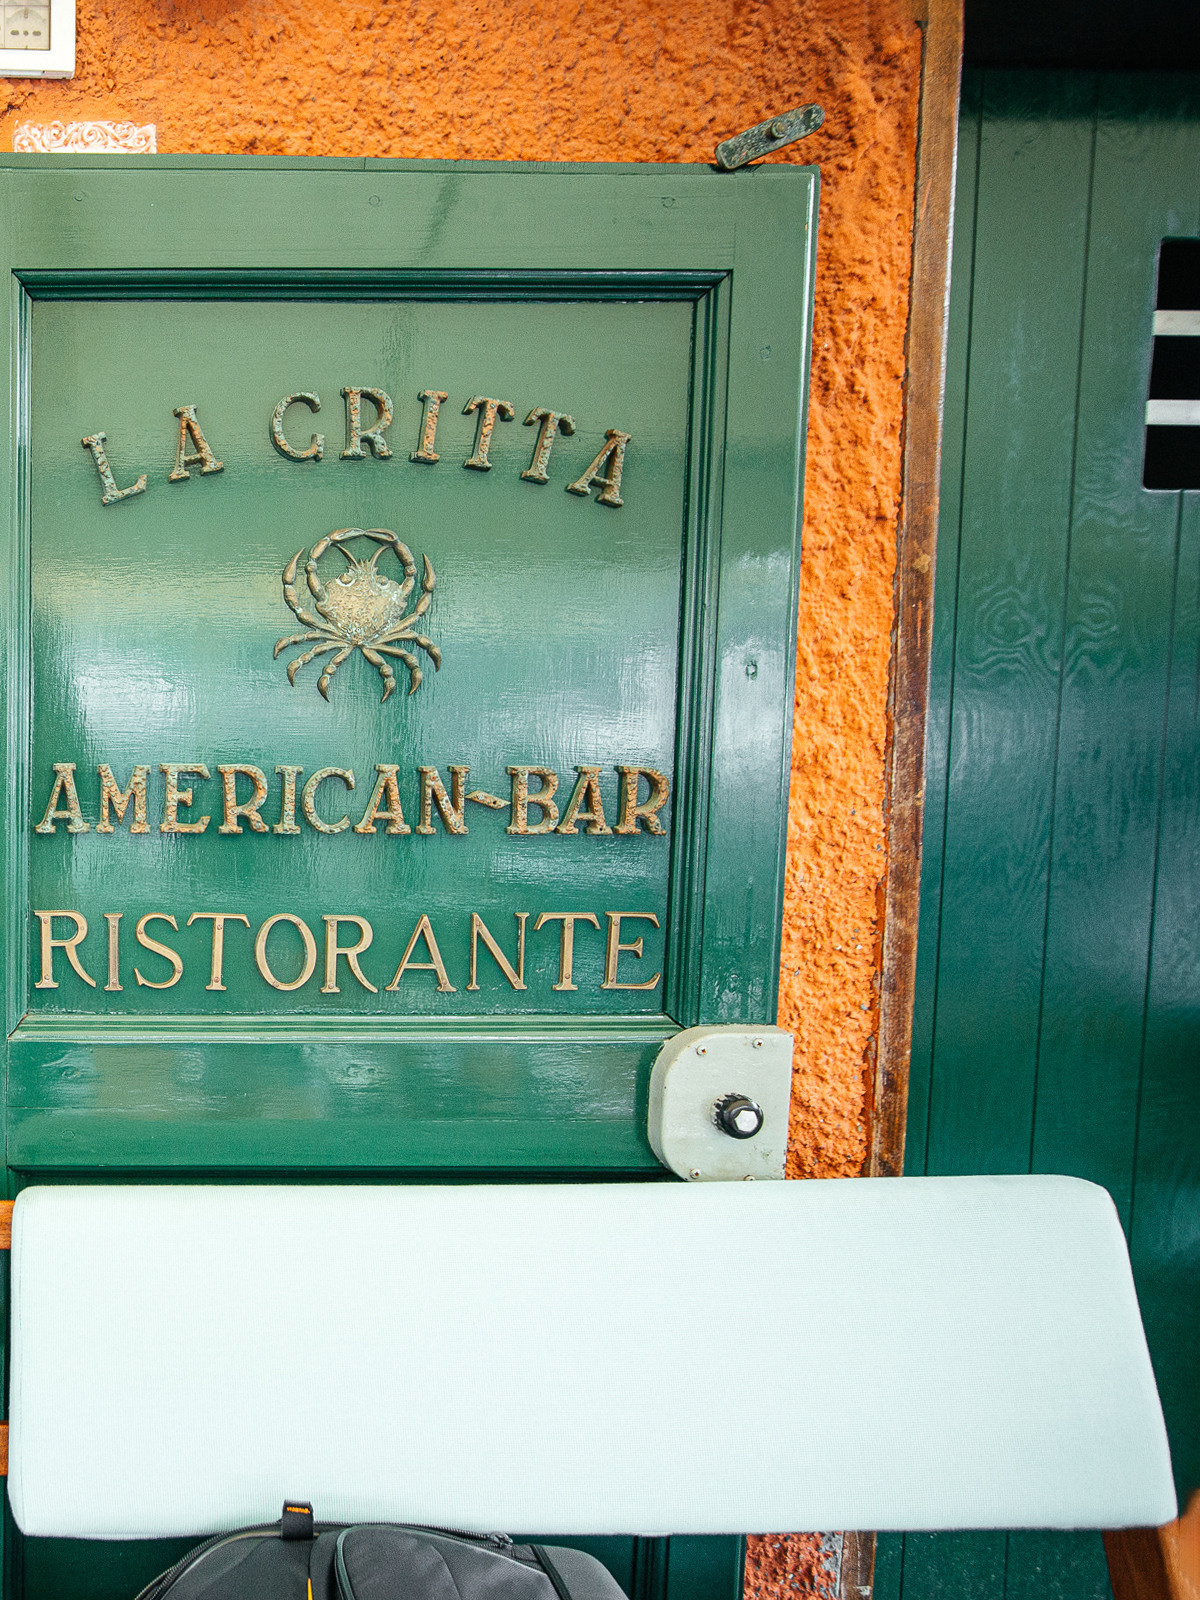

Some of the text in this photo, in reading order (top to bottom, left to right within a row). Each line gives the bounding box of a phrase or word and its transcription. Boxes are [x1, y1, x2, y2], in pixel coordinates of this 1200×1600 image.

[81, 386, 632, 508] LA GRITTA
[34, 910, 661, 994] RISTORANTE
